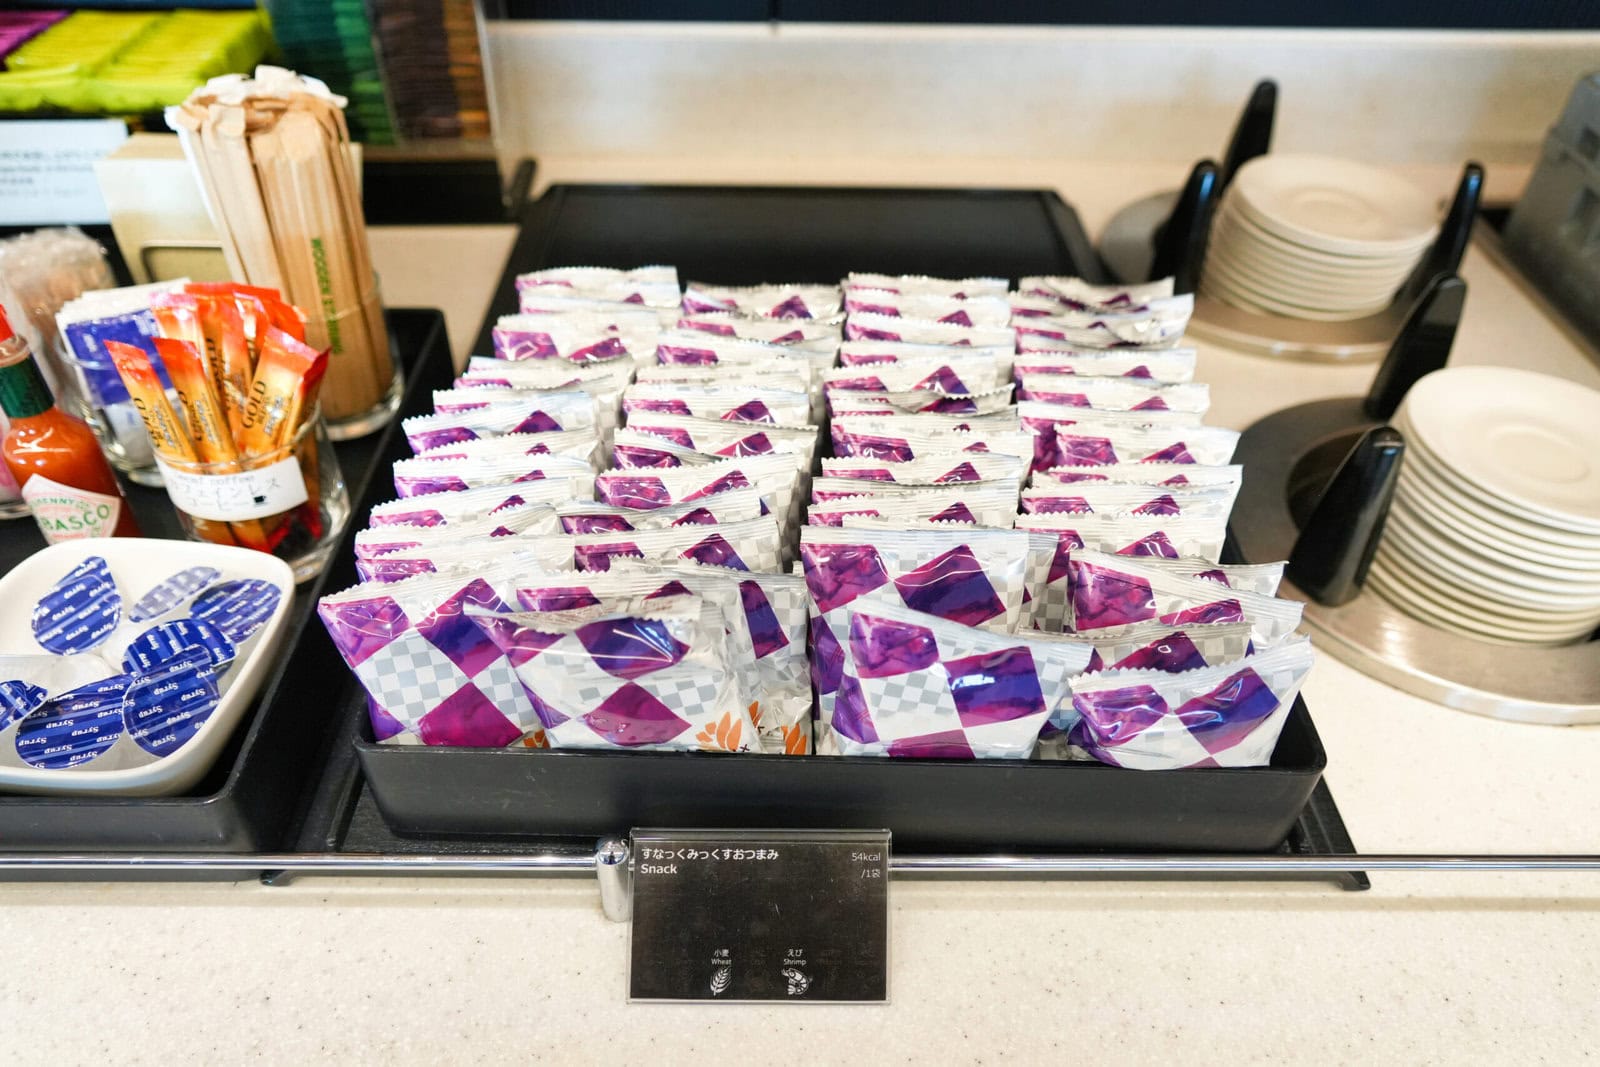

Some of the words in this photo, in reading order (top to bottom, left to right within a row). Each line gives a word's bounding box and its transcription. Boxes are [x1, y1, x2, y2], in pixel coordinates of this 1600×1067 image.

[242, 380, 266, 429] GOLD
[169, 660, 193, 672] Syrup
[196, 667, 215, 678] yrup
[98, 683, 125, 692] Syrup
[154, 682, 179, 694] Syrup
[181, 688, 206, 700] Syrup
[72, 701, 101, 710] Syrup
[138, 705, 163, 717] Syrup
[166, 711, 192, 724] Syrup
[45, 719, 74, 728] Syrup
[71, 726, 100, 736] Syrup
[18, 737, 47, 747] Syrup
[152, 734, 177, 746] Syrup
[44, 744, 73, 754] Syrup
[69, 751, 98, 761] Syrup
[641, 848, 779, 861] すなっくみっくすおつまみ
[851, 852, 881, 862] 54kcal
[640, 863, 677, 875] Snack
[860, 868, 881, 879] /1袋
[713, 948, 729, 957] 小麦
[787, 948, 803, 957] えび
[710, 958, 732, 966] Wheat
[783, 958, 807, 966] Shrimp
